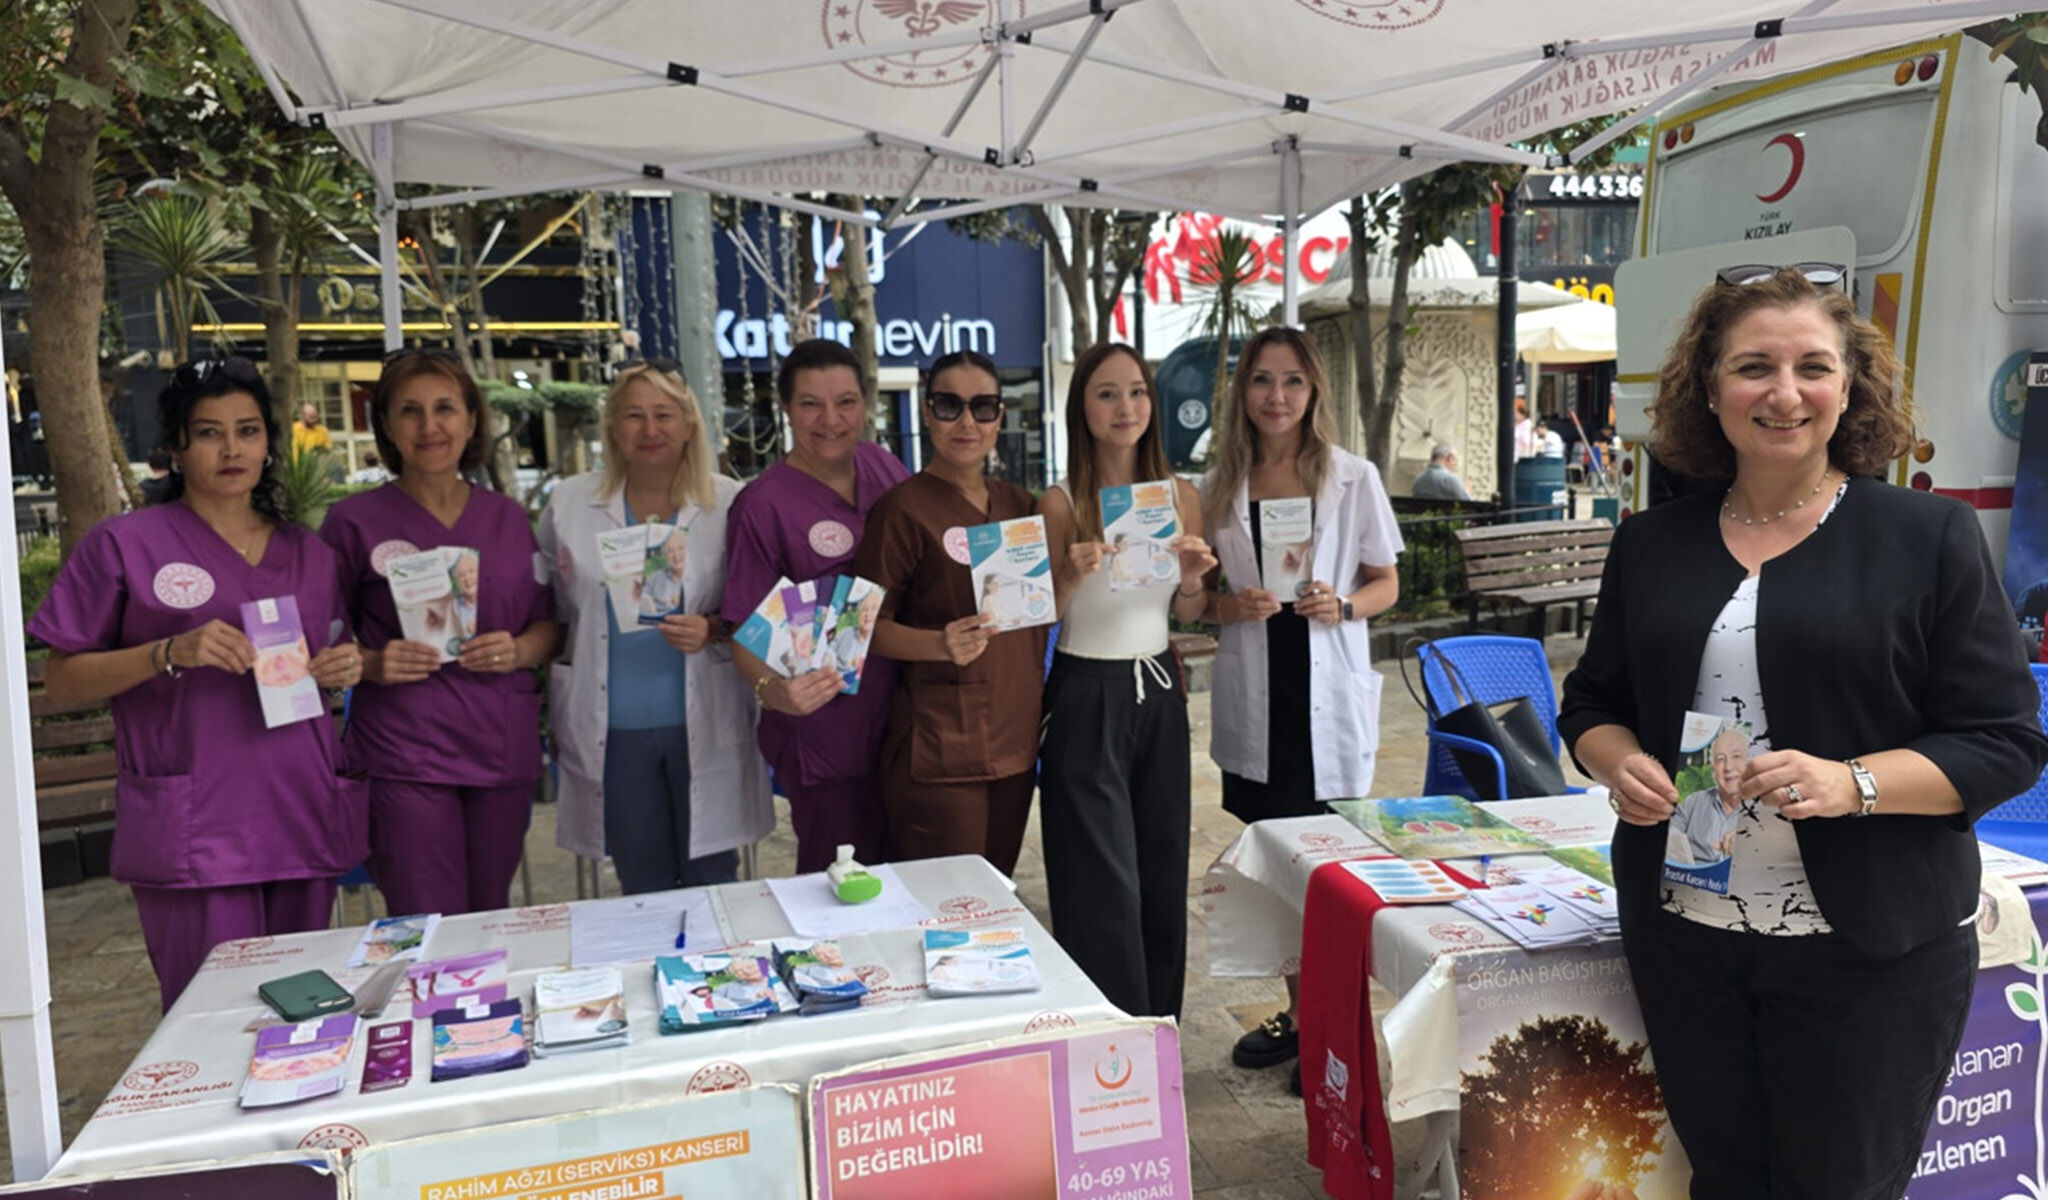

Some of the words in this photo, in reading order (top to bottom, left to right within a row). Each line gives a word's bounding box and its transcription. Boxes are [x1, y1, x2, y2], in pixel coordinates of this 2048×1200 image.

[1467, 967, 1534, 991] ORGAN
[1538, 959, 1595, 983] BAĞIŞI
[1599, 957, 1629, 976] HA
[834, 1076, 957, 1117] HAYATINIZ
[1936, 1088, 2012, 1127] Organ
[836, 1116, 904, 1148] BİZİM
[908, 1105, 957, 1138] İÇİN
[427, 1177, 498, 1200] RAHİM
[502, 1167, 552, 1193] AĞZI
[556, 1150, 656, 1184] (SERVİKS)
[660, 1131, 744, 1165] KANSERİ
[838, 1133, 984, 1181] DEĞERLİDİR!
[1067, 1165, 1126, 1193] 40-69
[1129, 1157, 1171, 1182] YAŞ
